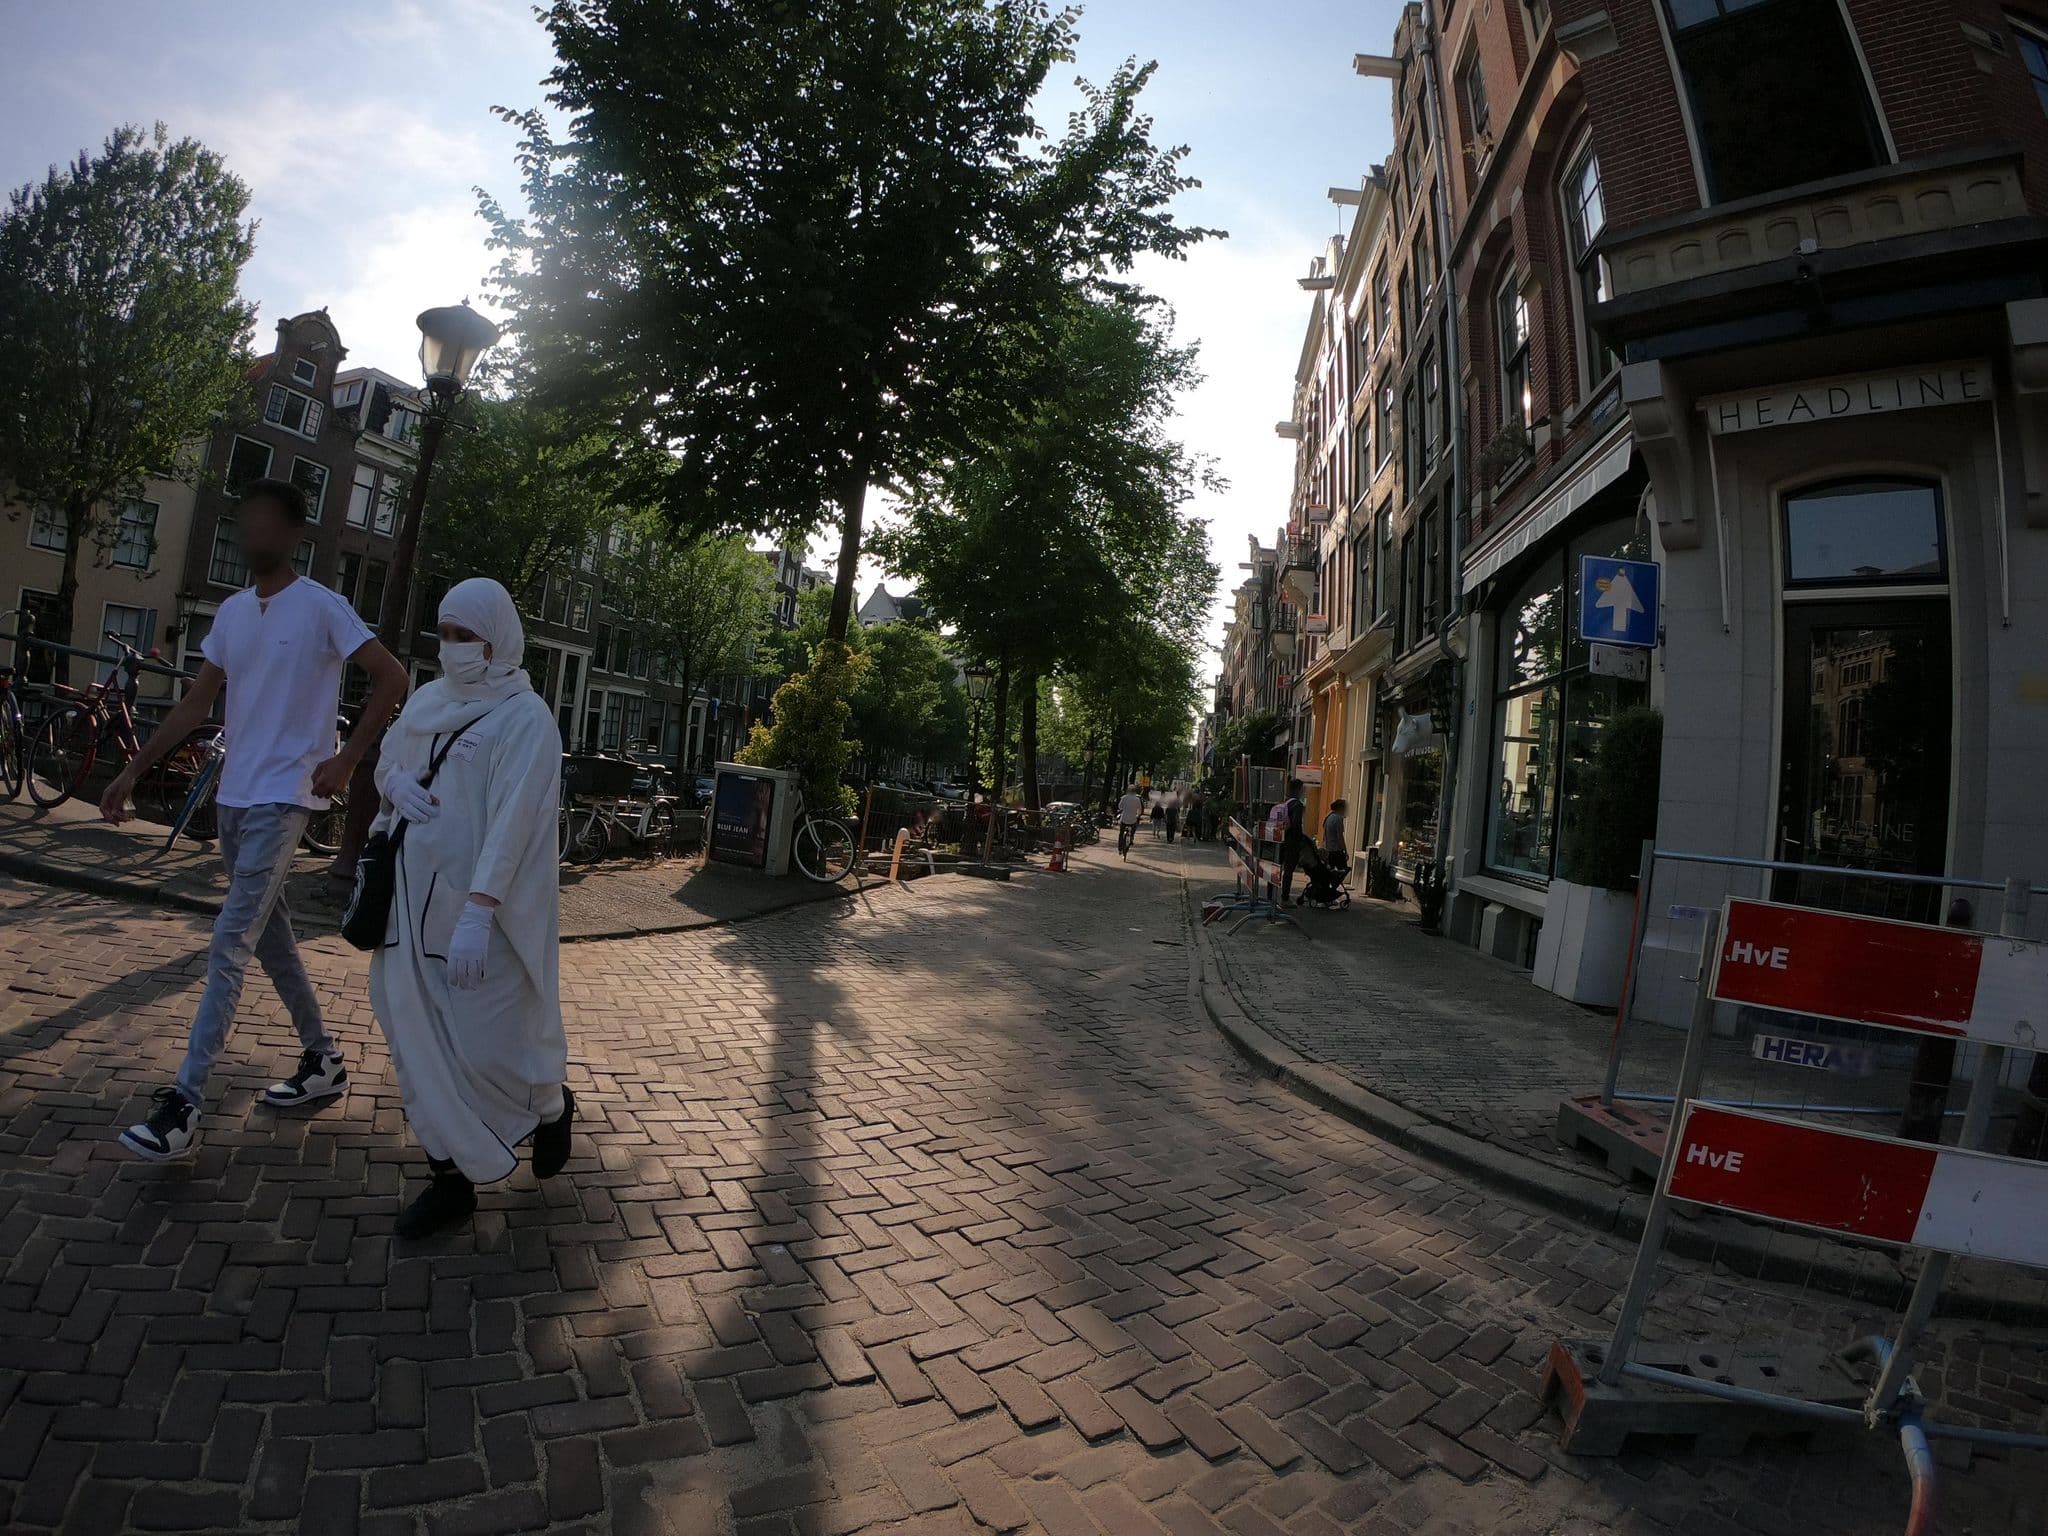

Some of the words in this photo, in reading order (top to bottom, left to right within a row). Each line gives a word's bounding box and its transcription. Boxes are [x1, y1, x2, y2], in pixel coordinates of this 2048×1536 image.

[1718, 368, 1981, 431] HEADLINE
[1812, 817, 1914, 842] EADINE
[1731, 940, 1790, 970] HvE
[1762, 1037, 1866, 1073] HERA
[1686, 1143, 1745, 1173] HvE
